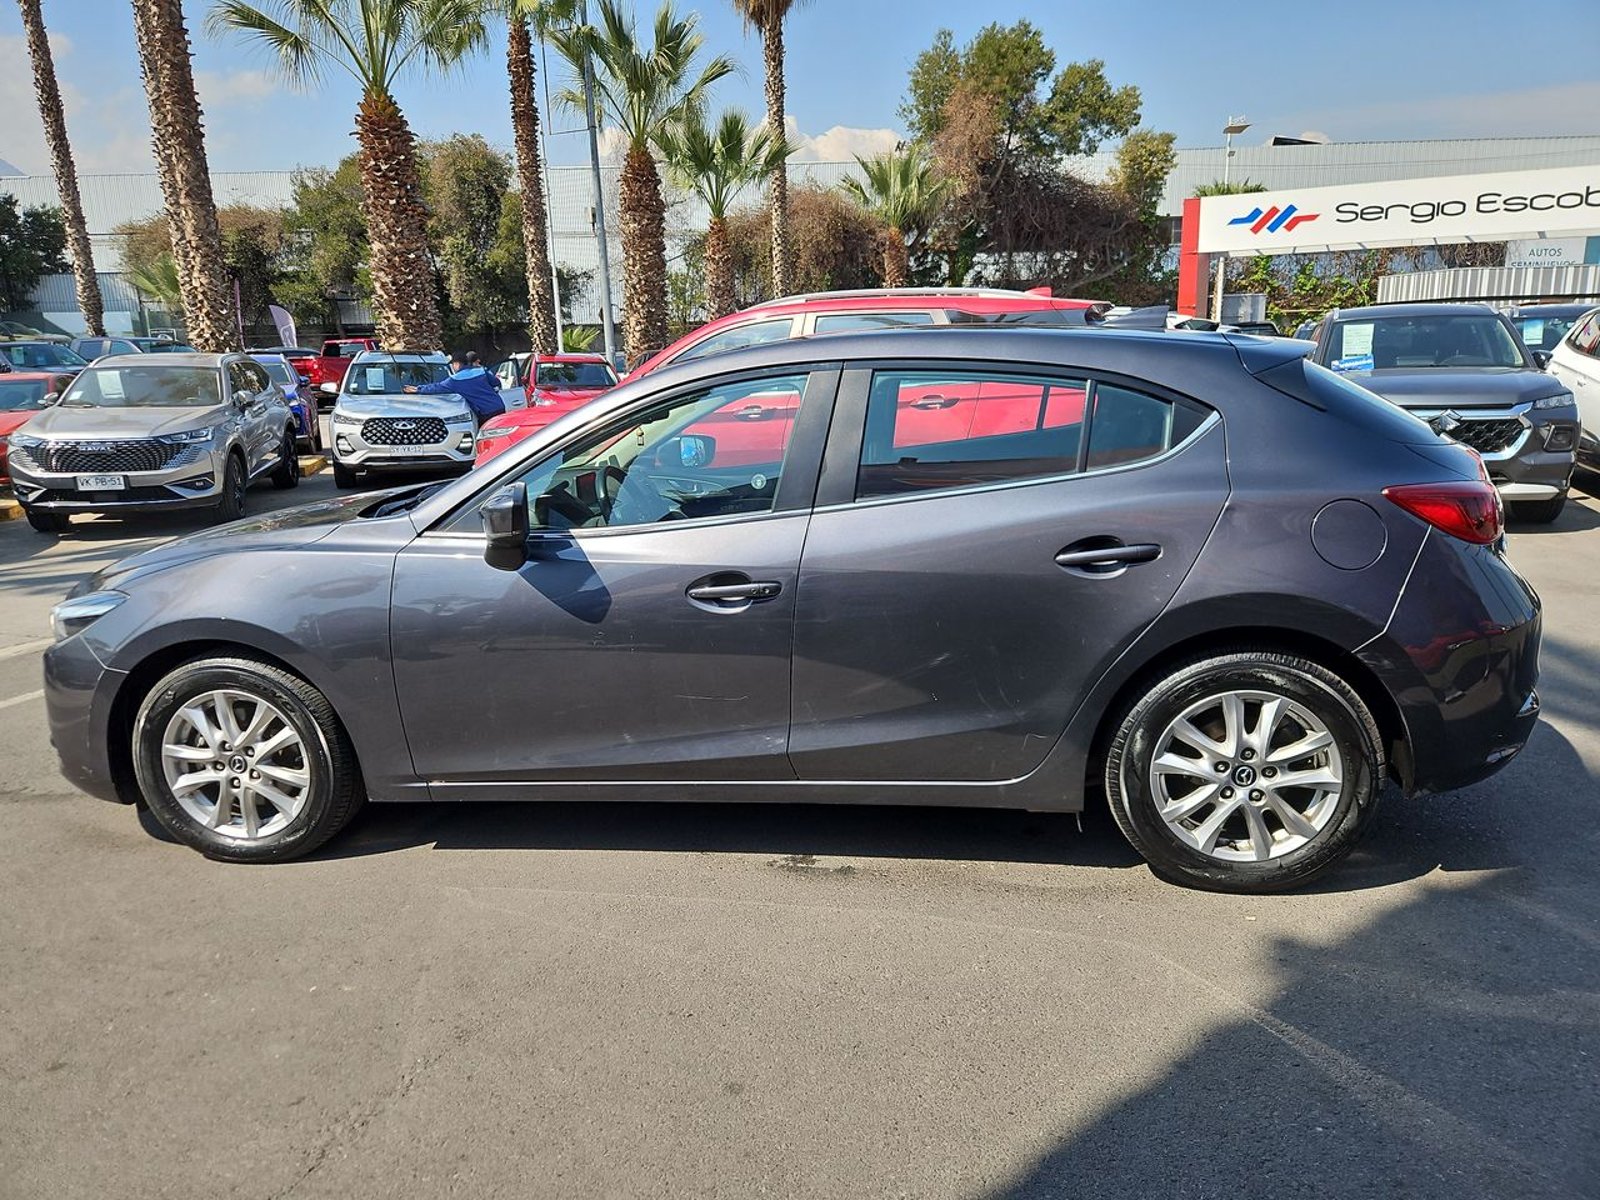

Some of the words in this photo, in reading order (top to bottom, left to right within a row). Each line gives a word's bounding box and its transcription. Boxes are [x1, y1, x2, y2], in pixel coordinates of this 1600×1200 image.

[1335, 200, 1467, 223] Sergio
[1475, 185, 1600, 213] Escob
[1528, 248, 1563, 257] AUTOS
